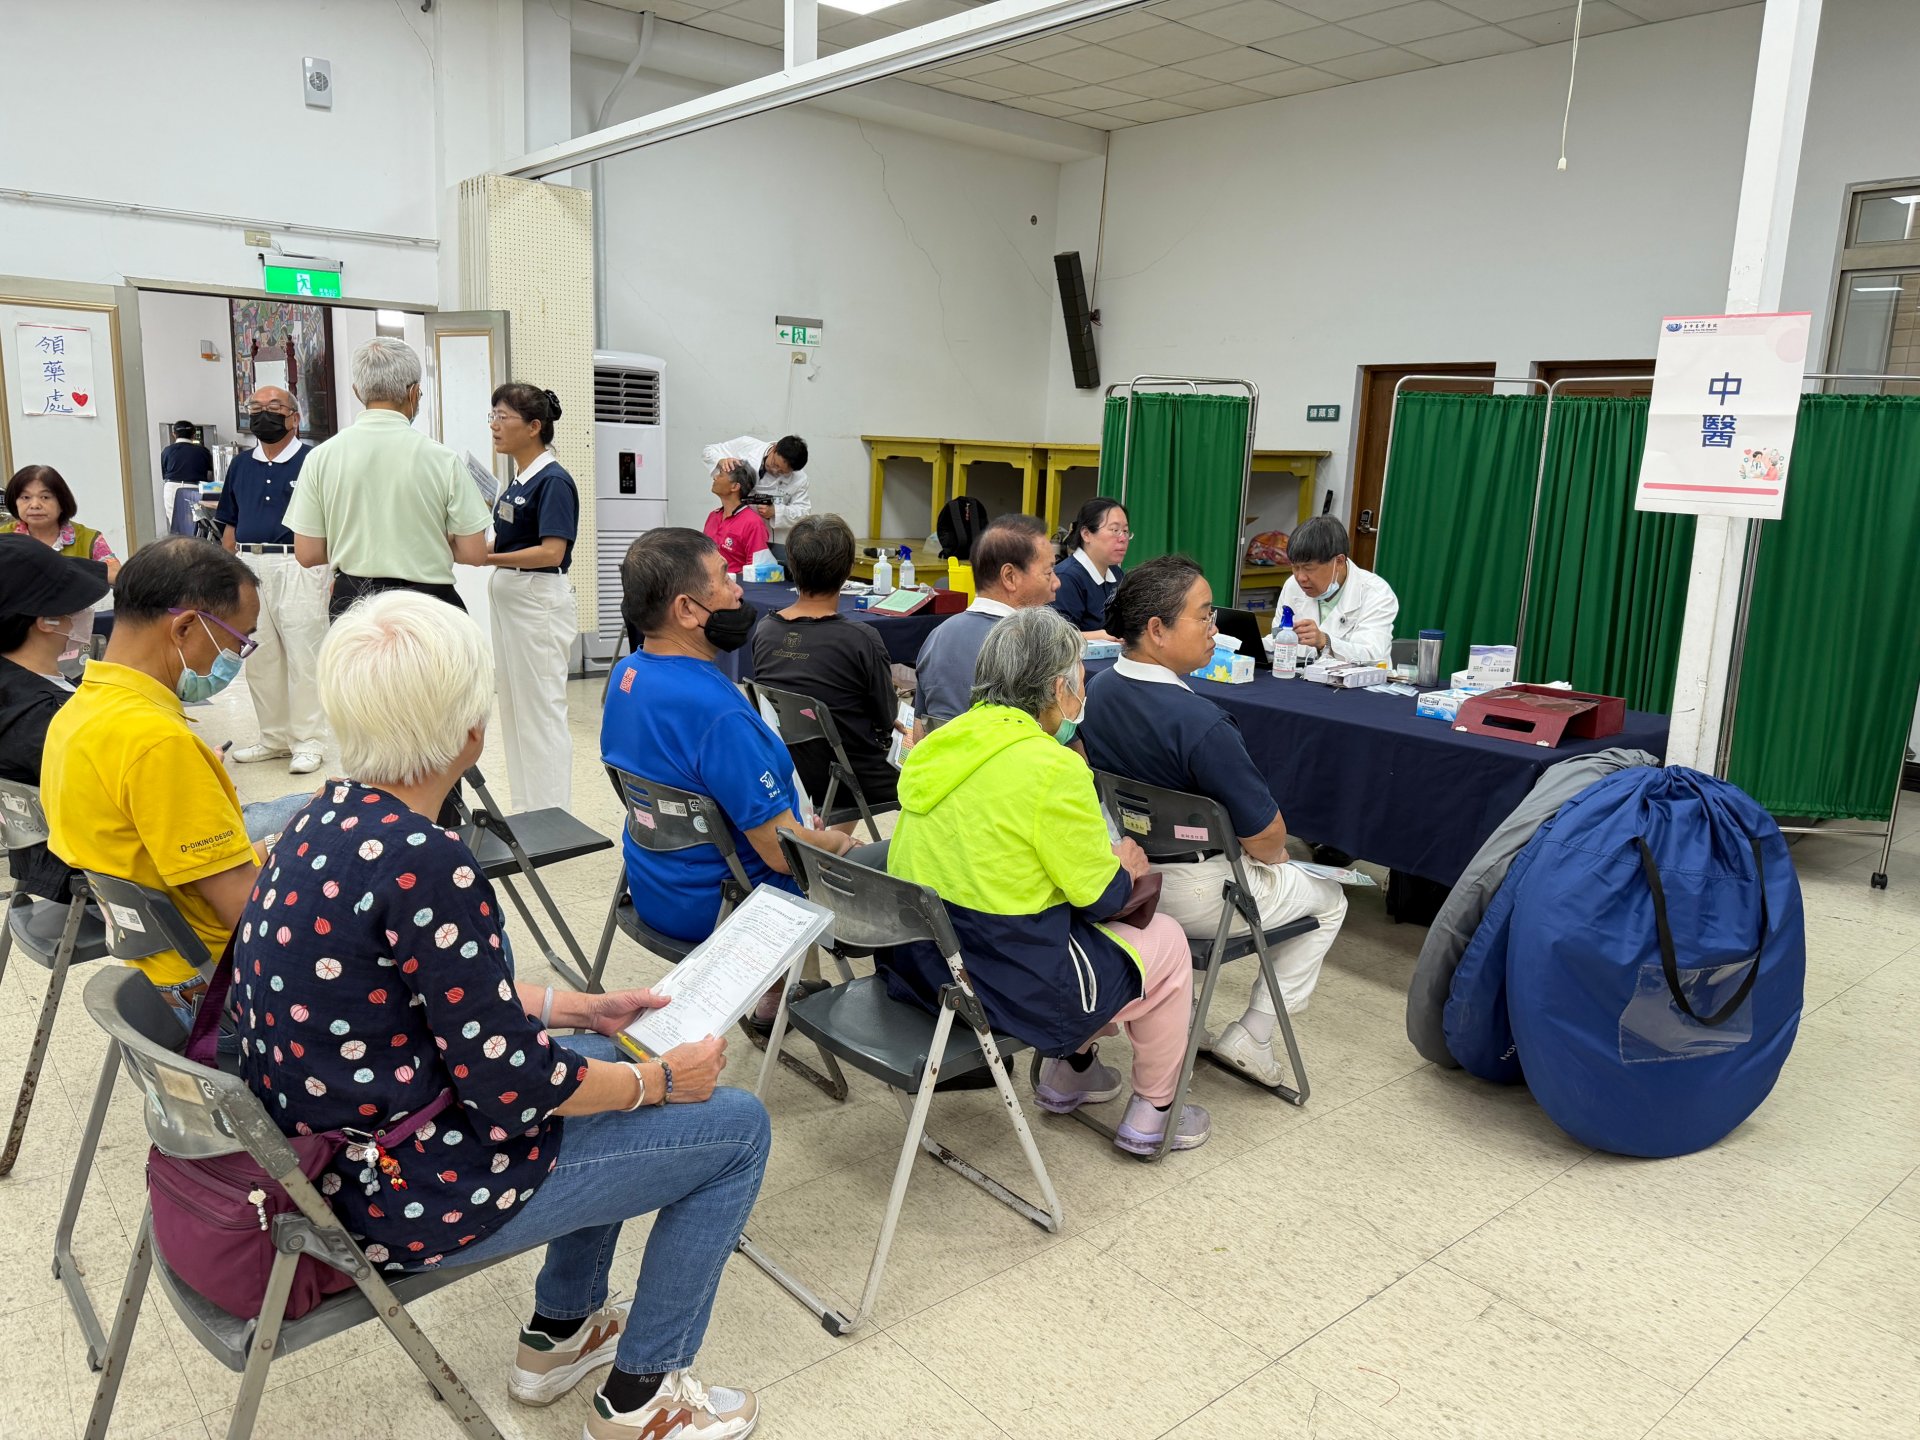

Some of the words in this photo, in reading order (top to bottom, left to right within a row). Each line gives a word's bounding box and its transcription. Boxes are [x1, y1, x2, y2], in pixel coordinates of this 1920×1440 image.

[35, 335, 74, 414] 領藥處
[1701, 371, 1742, 448] 中醫
